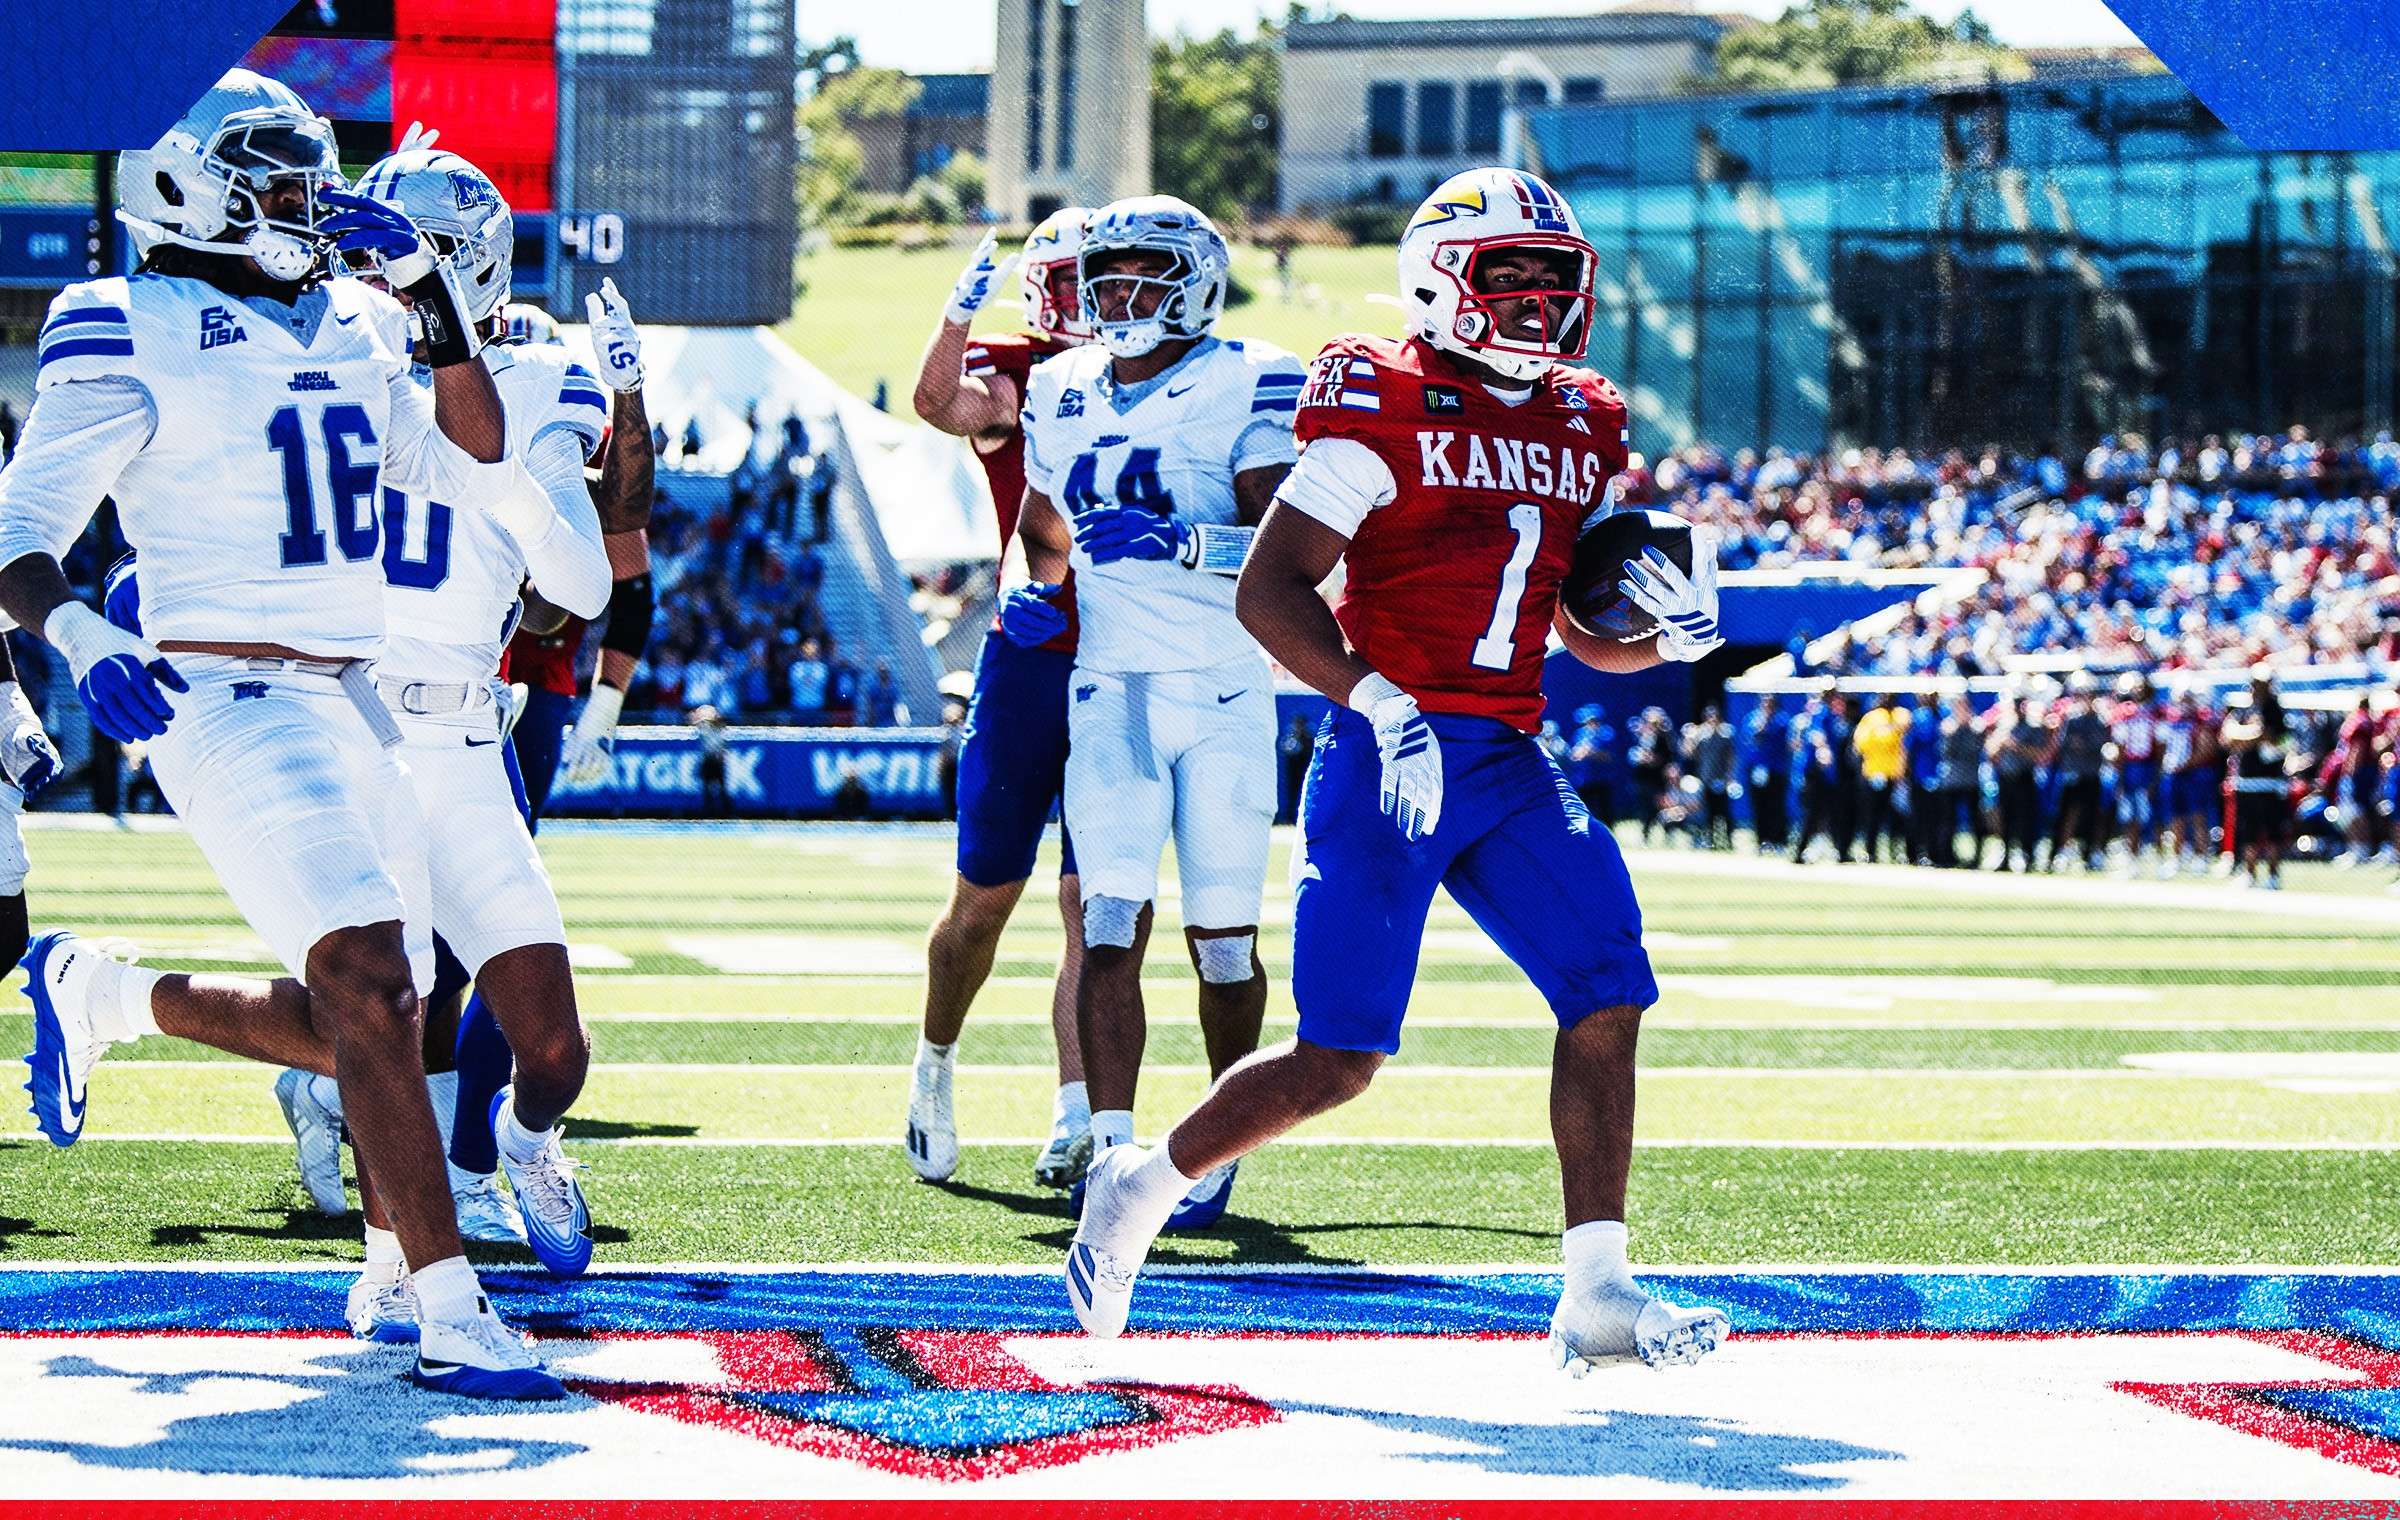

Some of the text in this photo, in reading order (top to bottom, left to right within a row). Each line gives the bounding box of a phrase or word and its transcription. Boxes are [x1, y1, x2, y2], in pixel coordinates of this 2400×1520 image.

[560, 213, 624, 264] 40
[200, 326, 248, 351] USA
[294, 371, 329, 382] MIDDLE
[1056, 404, 1085, 418] USA
[264, 402, 380, 569] 16
[1062, 447, 1178, 517] 44
[1416, 431, 1601, 506] KANSAS
[1470, 501, 1543, 673] 1
